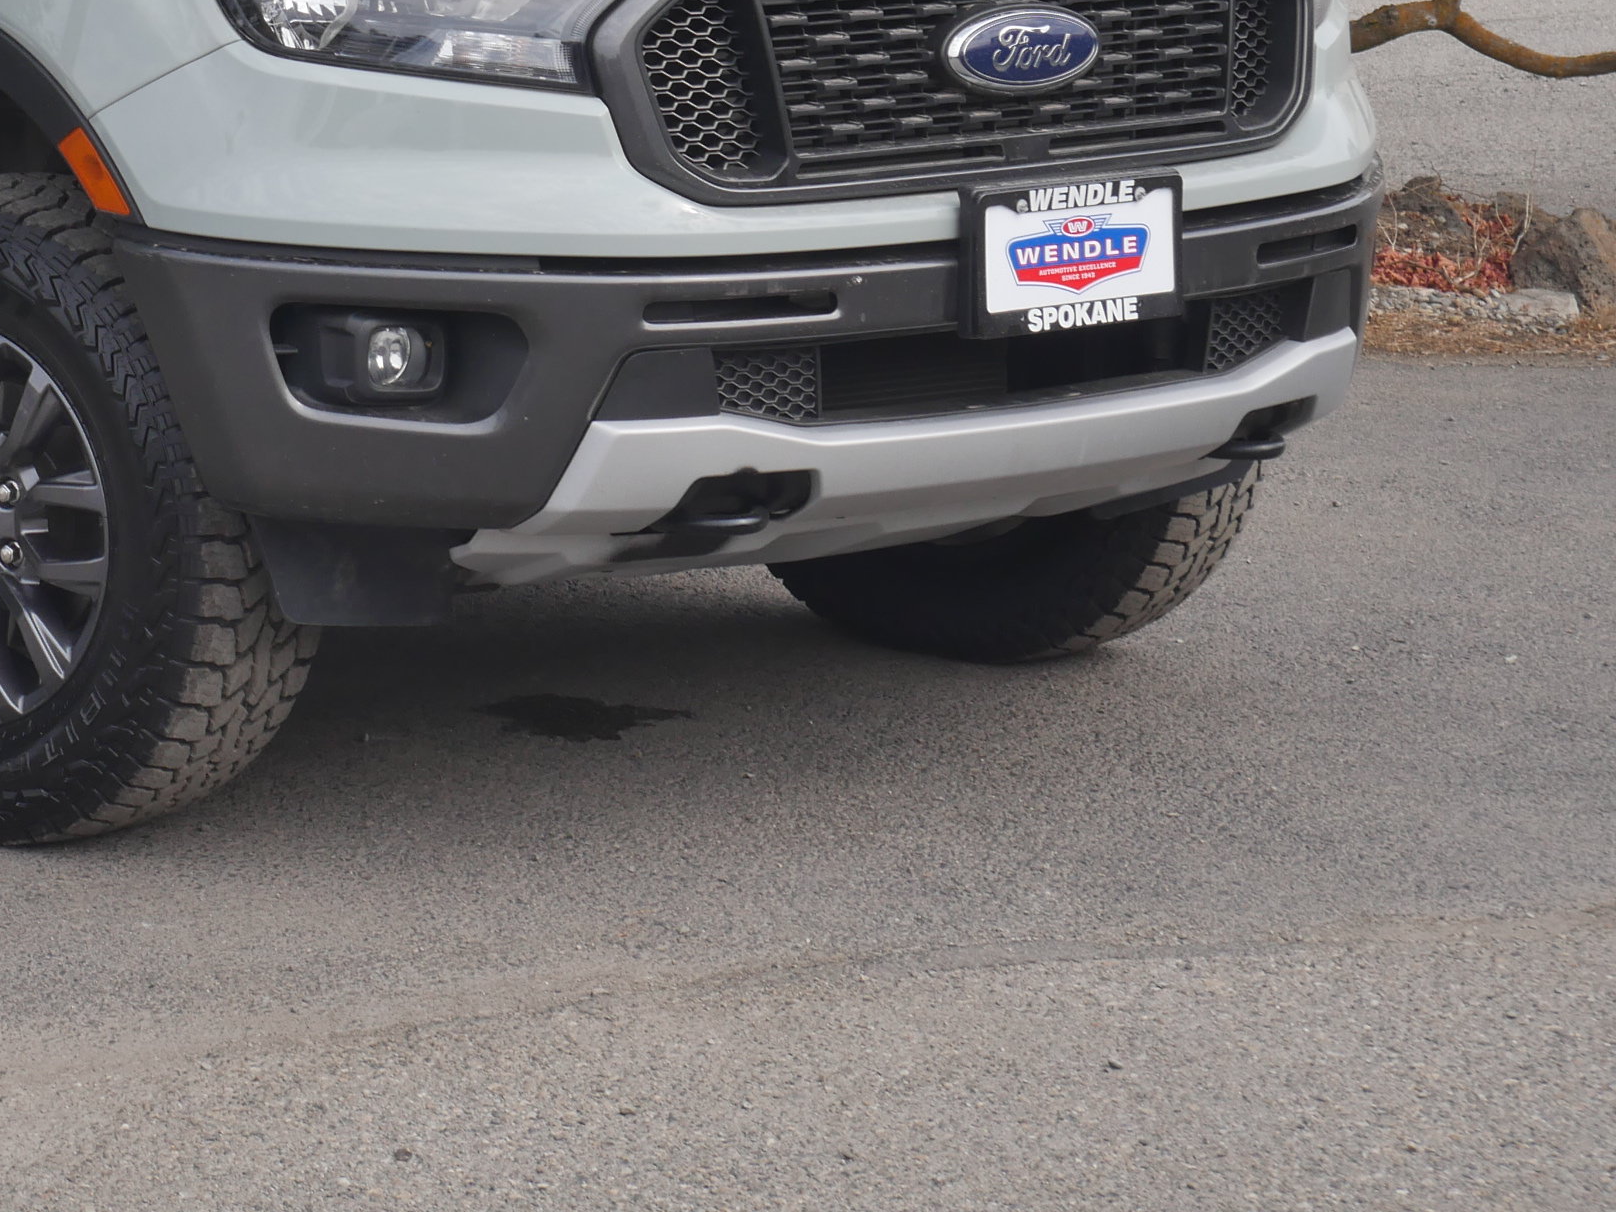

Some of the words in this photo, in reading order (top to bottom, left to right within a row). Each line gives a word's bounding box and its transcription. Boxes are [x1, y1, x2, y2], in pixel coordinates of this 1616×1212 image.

[992, 25, 1072, 72] Ford
[1029, 179, 1135, 212] WENDLE
[1016, 236, 1137, 265] WENDLE
[1039, 265, 1078, 276] AUTOMOTIVE
[1078, 261, 1117, 272] EXCELLENCE
[1061, 273, 1080, 282] SINCE
[1027, 297, 1139, 333] SPOKANE
